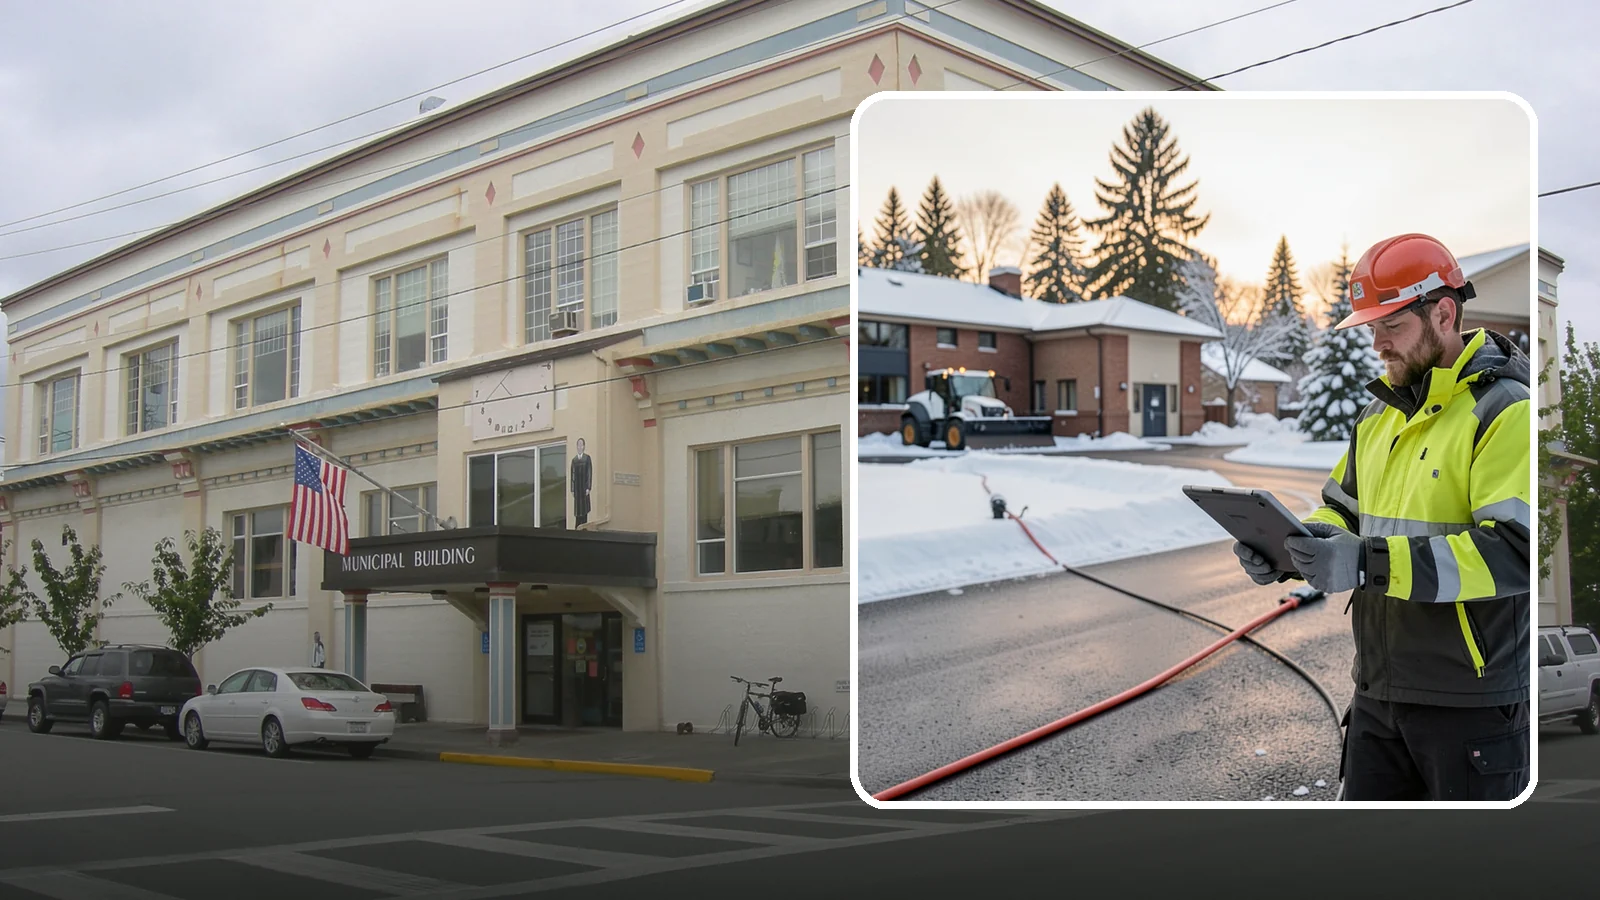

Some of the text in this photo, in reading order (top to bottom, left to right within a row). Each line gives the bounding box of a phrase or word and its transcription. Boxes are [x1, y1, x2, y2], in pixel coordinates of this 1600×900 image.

[536, 402, 540, 410] 4
[481, 407, 485, 415] 8
[488, 417, 492, 426] 9
[521, 420, 526, 428] 2
[494, 423, 500, 432] 10
[507, 425, 513, 433] 12
[342, 546, 475, 572] MUNICIPAL BUILDING
